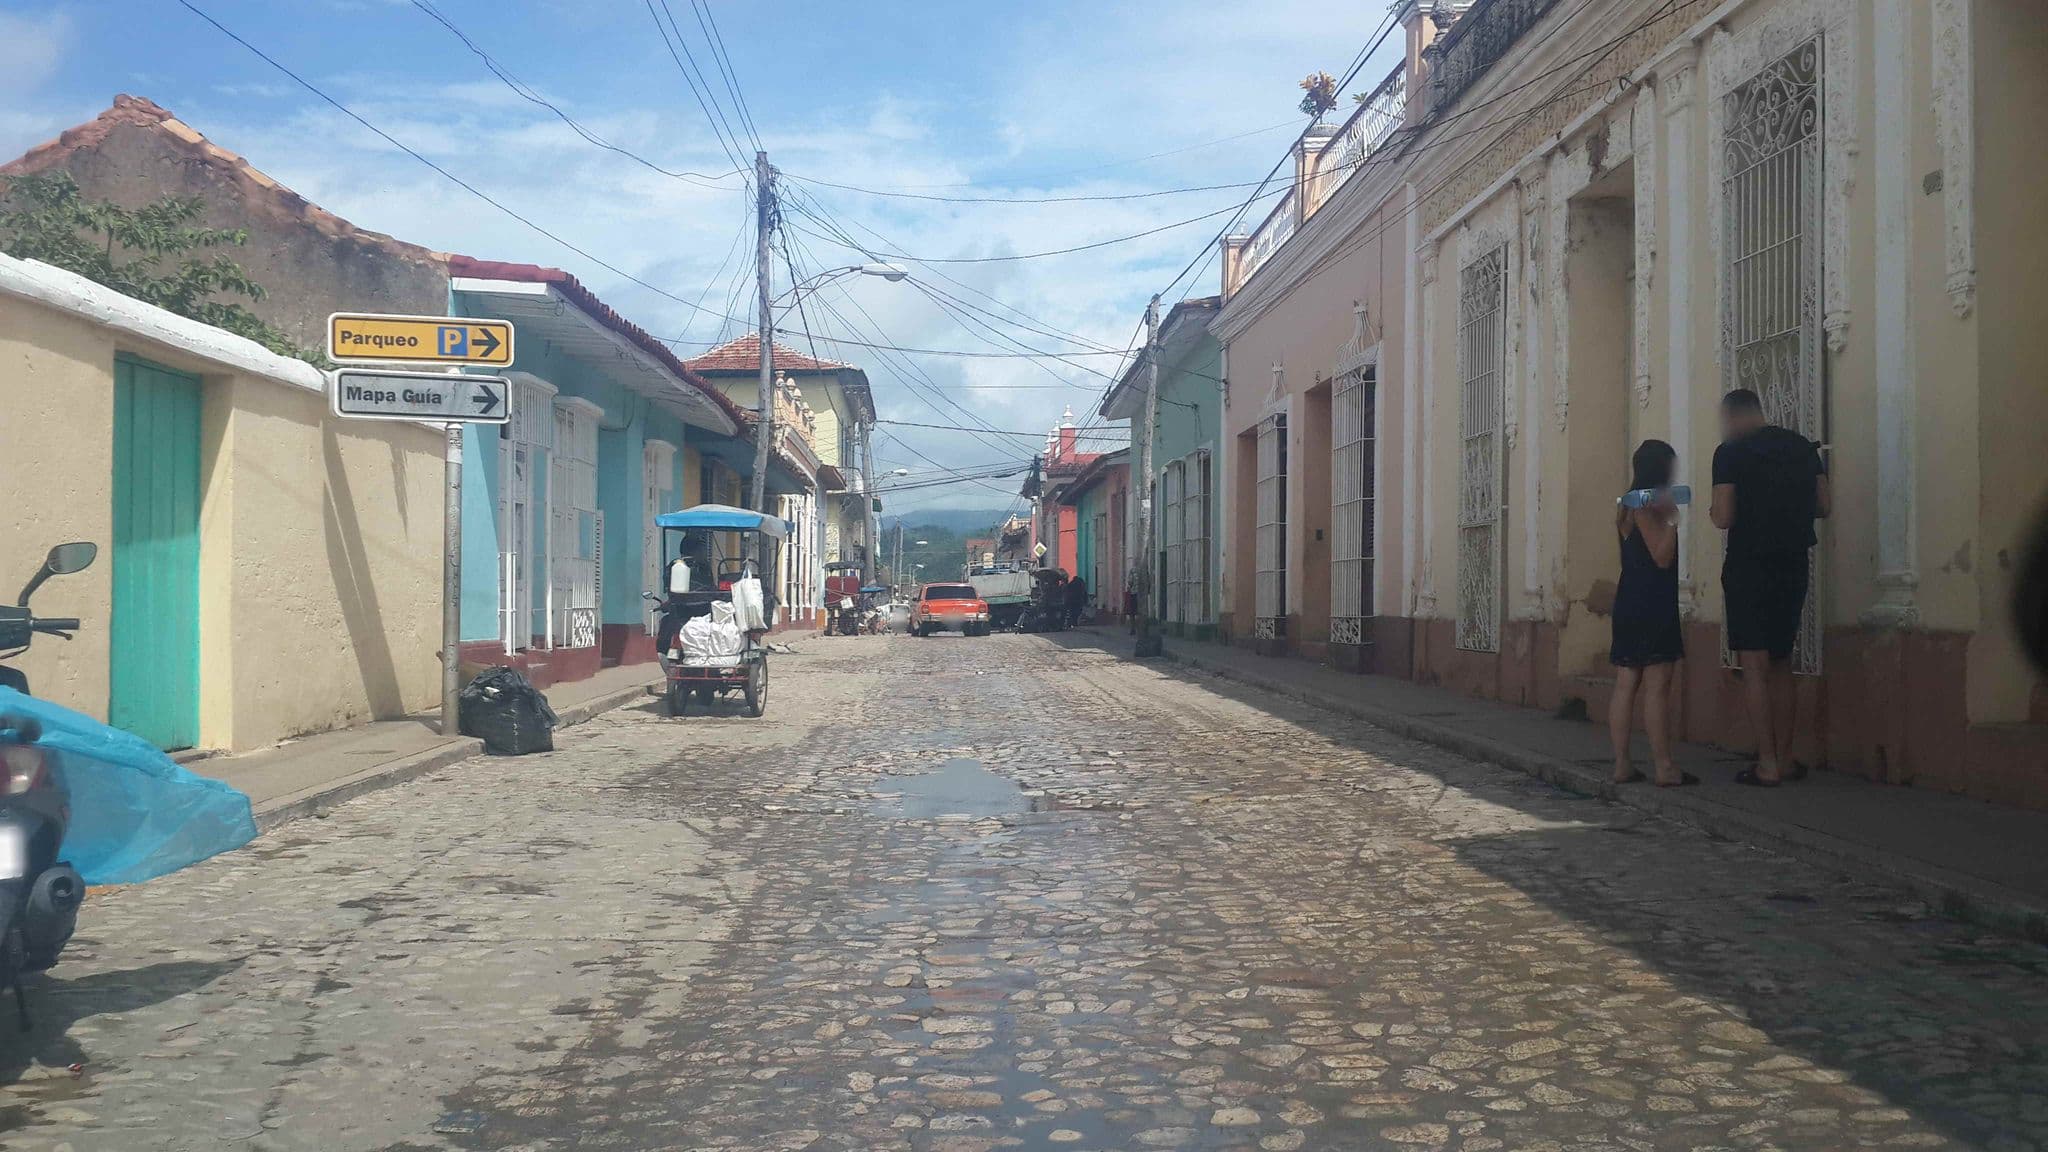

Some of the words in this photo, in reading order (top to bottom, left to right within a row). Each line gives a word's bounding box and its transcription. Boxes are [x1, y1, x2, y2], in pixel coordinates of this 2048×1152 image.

[340, 330, 418, 348] Parqueo
[443, 329, 463, 354] P
[346, 386, 396, 404] Mapa
[402, 388, 442, 404] Guía
